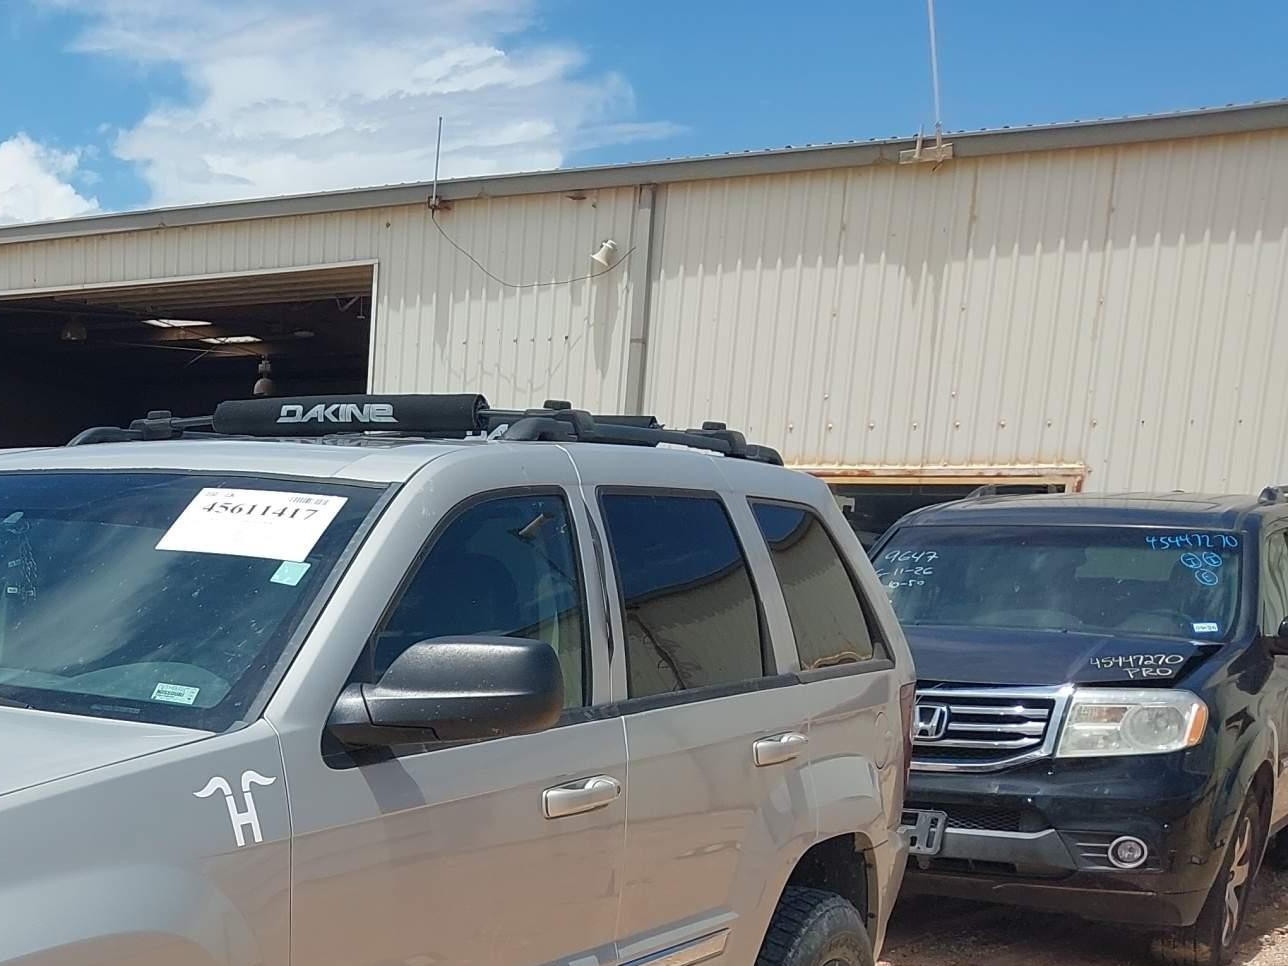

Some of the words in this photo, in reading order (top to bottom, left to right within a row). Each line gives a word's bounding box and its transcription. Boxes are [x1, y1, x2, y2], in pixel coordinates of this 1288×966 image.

[276, 403, 399, 423] DAKINE
[202, 501, 320, 521] 45611417
[1145, 533, 1239, 550] 45447270
[884, 550, 940, 563] 9647
[1089, 653, 1184, 669] 45447270
[1122, 667, 1173, 679] PRO
